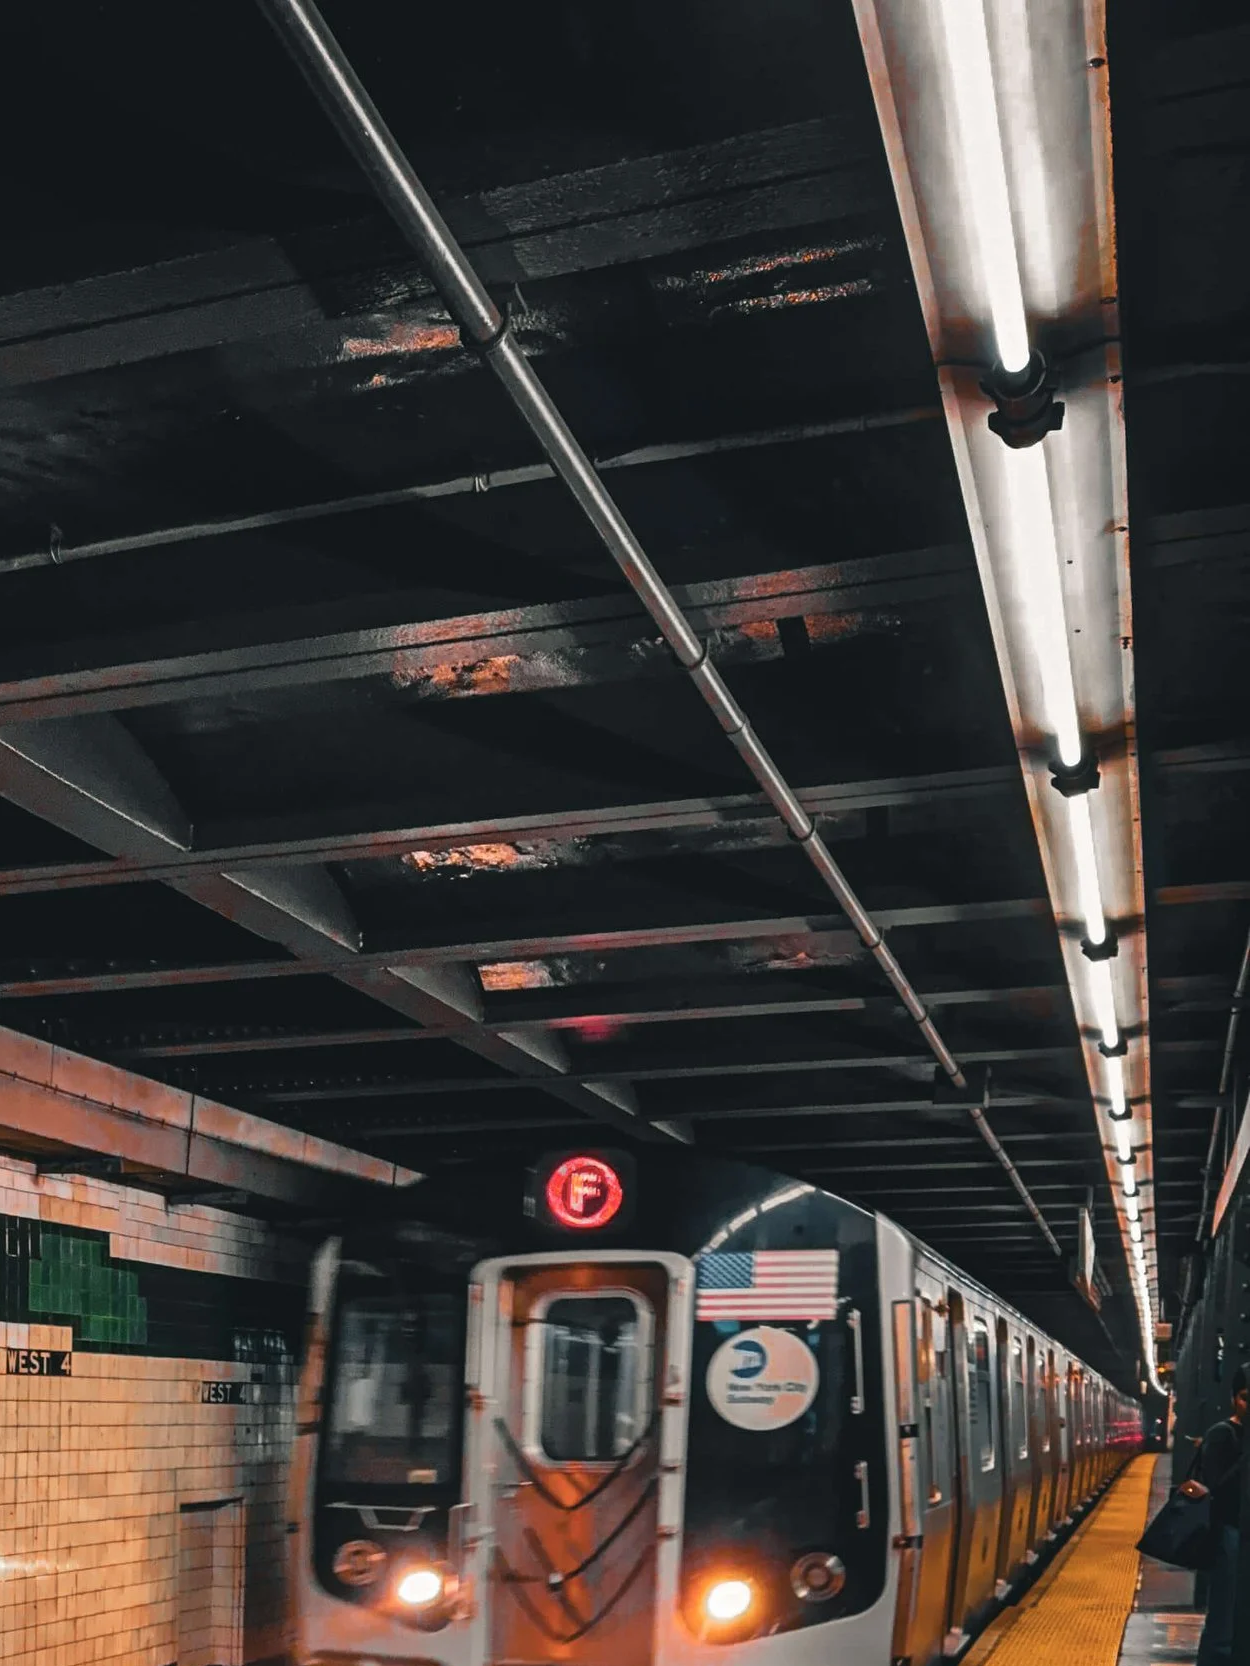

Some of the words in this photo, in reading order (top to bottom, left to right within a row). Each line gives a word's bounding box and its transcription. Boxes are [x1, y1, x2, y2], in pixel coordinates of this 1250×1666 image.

[569, 1173, 601, 1213] F
[7, 1349, 50, 1375] WEST
[61, 1353, 70, 1375] 4
[202, 1382, 232, 1402] WEST
